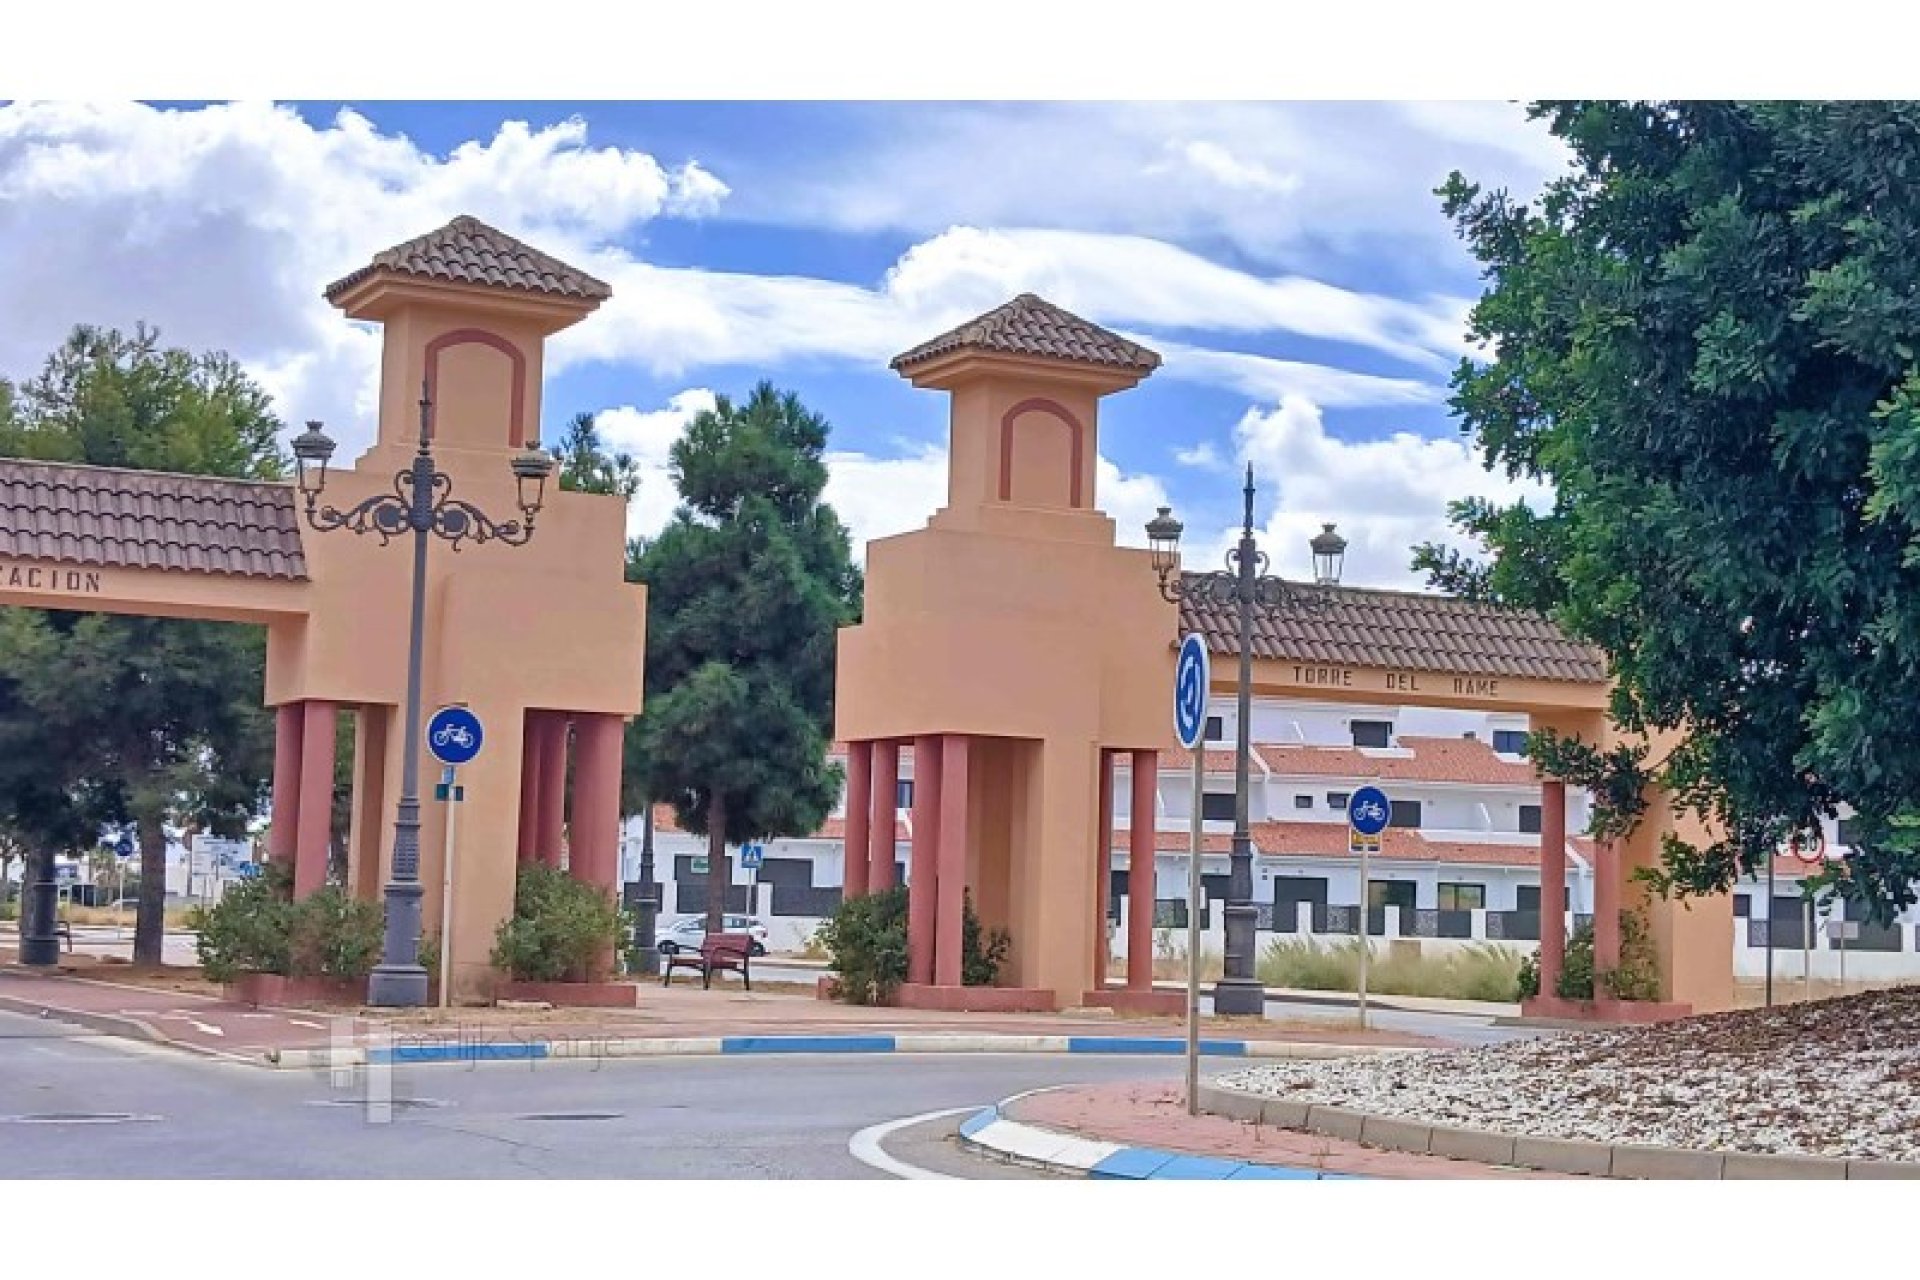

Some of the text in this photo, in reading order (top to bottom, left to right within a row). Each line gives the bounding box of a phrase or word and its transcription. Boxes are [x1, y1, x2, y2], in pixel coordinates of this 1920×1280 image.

[0, 565, 99, 592] ACION
[1292, 665, 1352, 687] TORRE
[1385, 672, 1419, 692] DEL
